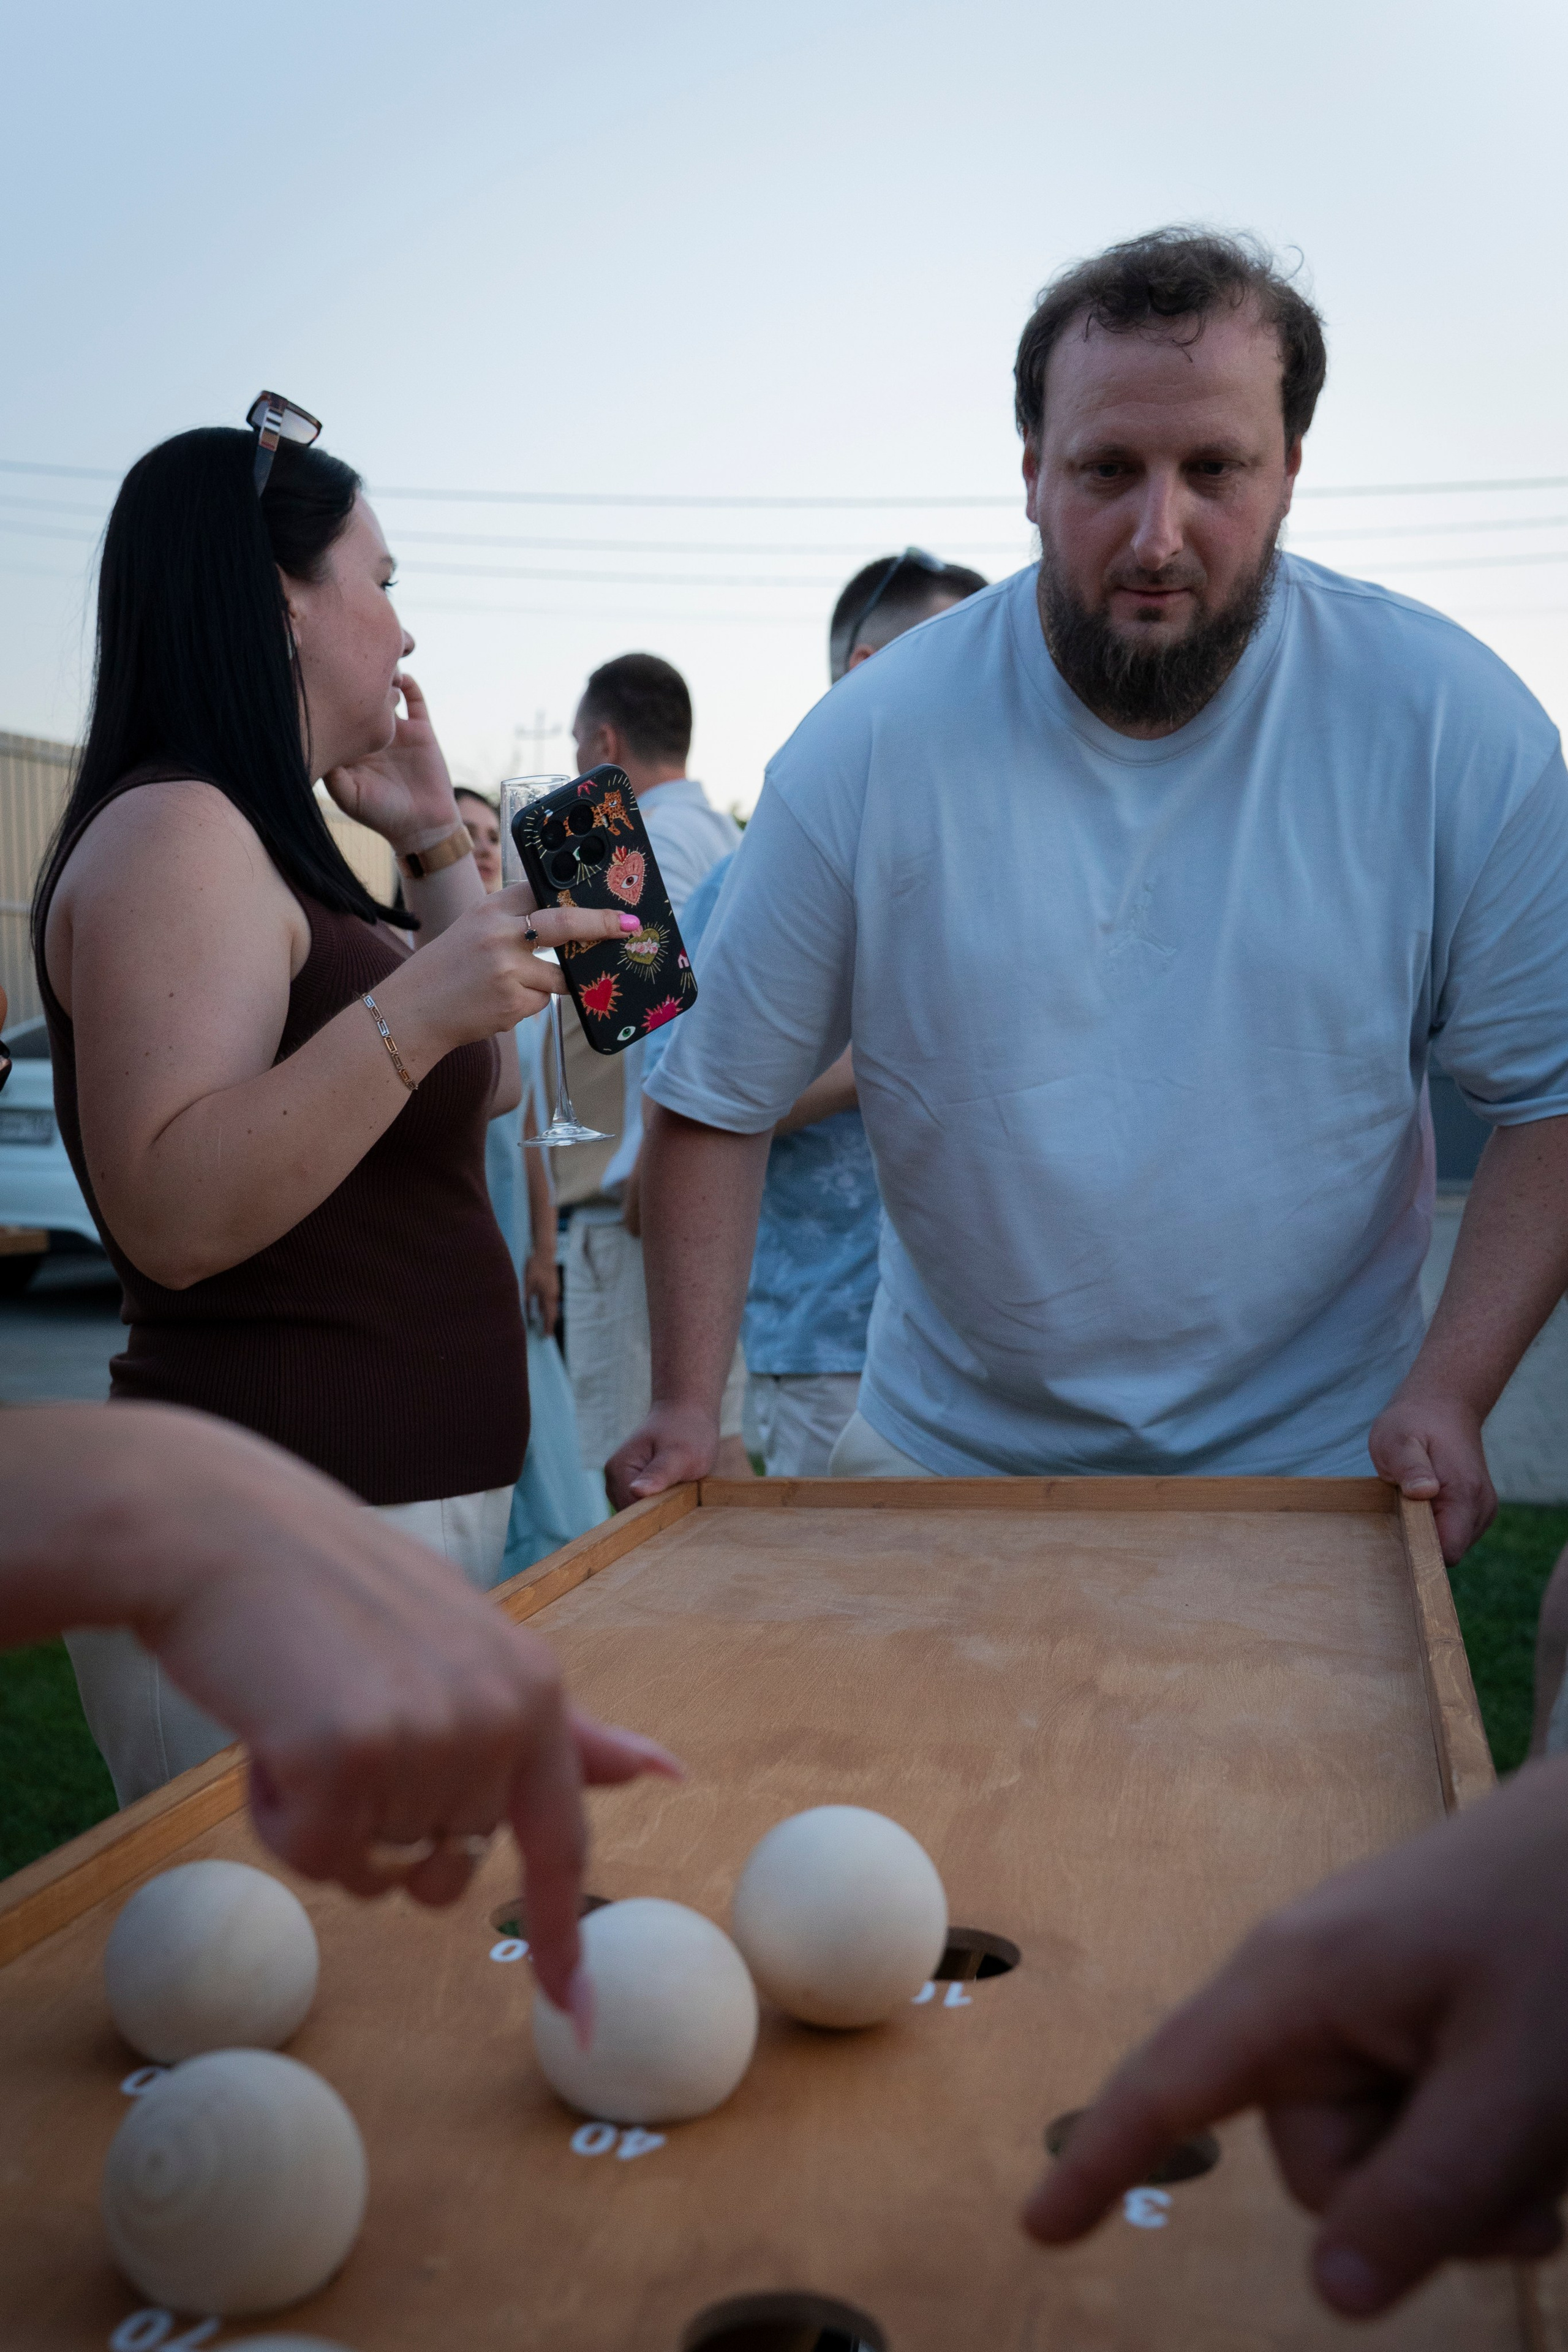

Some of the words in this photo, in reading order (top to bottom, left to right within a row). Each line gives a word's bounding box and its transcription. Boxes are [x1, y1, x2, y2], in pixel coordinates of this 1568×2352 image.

[489, 1938, 532, 1962] 0
[120, 2065, 164, 2095] 0
[570, 2123, 667, 2161] 40
[1123, 2187, 1171, 2228] 3
